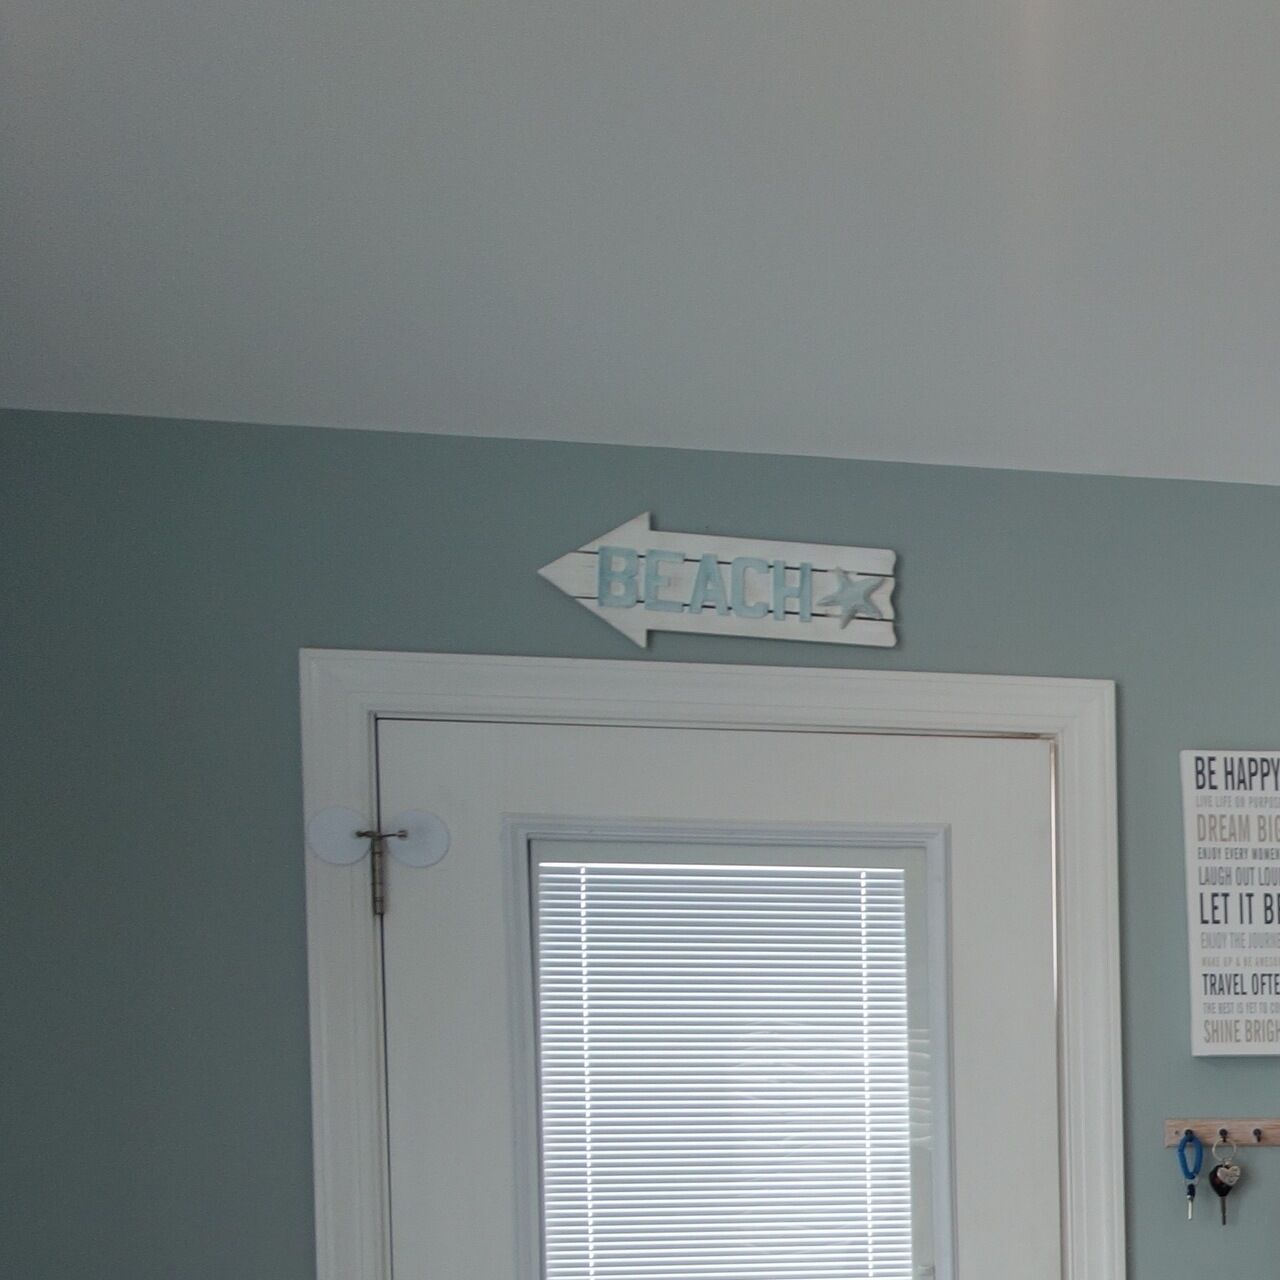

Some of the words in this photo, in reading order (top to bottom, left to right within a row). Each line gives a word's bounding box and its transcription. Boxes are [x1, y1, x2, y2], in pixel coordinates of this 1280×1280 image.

[597, 545, 813, 622] BEACH
[1194, 756, 1218, 790] BE
[1223, 756, 1280, 791] HAPPY
[1196, 795, 1213, 808] LIVE
[1215, 795, 1232, 808] LIFE
[1235, 796, 1245, 808] ON
[1197, 814, 1250, 842] DREAM
[1198, 847, 1221, 860] ENJOY
[1225, 847, 1248, 860] EVERY
[1199, 866, 1232, 886] LAUGH
[1235, 866, 1254, 886] OUT
[1199, 892, 1230, 925] LET
[1239, 892, 1254, 925] IT
[1201, 932, 1226, 949] ENJOY
[1230, 932, 1245, 949] THE
[1202, 973, 1247, 996] TRAVEL
[1202, 1002, 1216, 1014] THE
[1218, 1002, 1234, 1014] BEST
[1236, 1002, 1244, 1014] IS
[1246, 1002, 1257, 1014] YET
[1259, 1002, 1267, 1014] TO
[1203, 1019, 1241, 1044] SHINE
